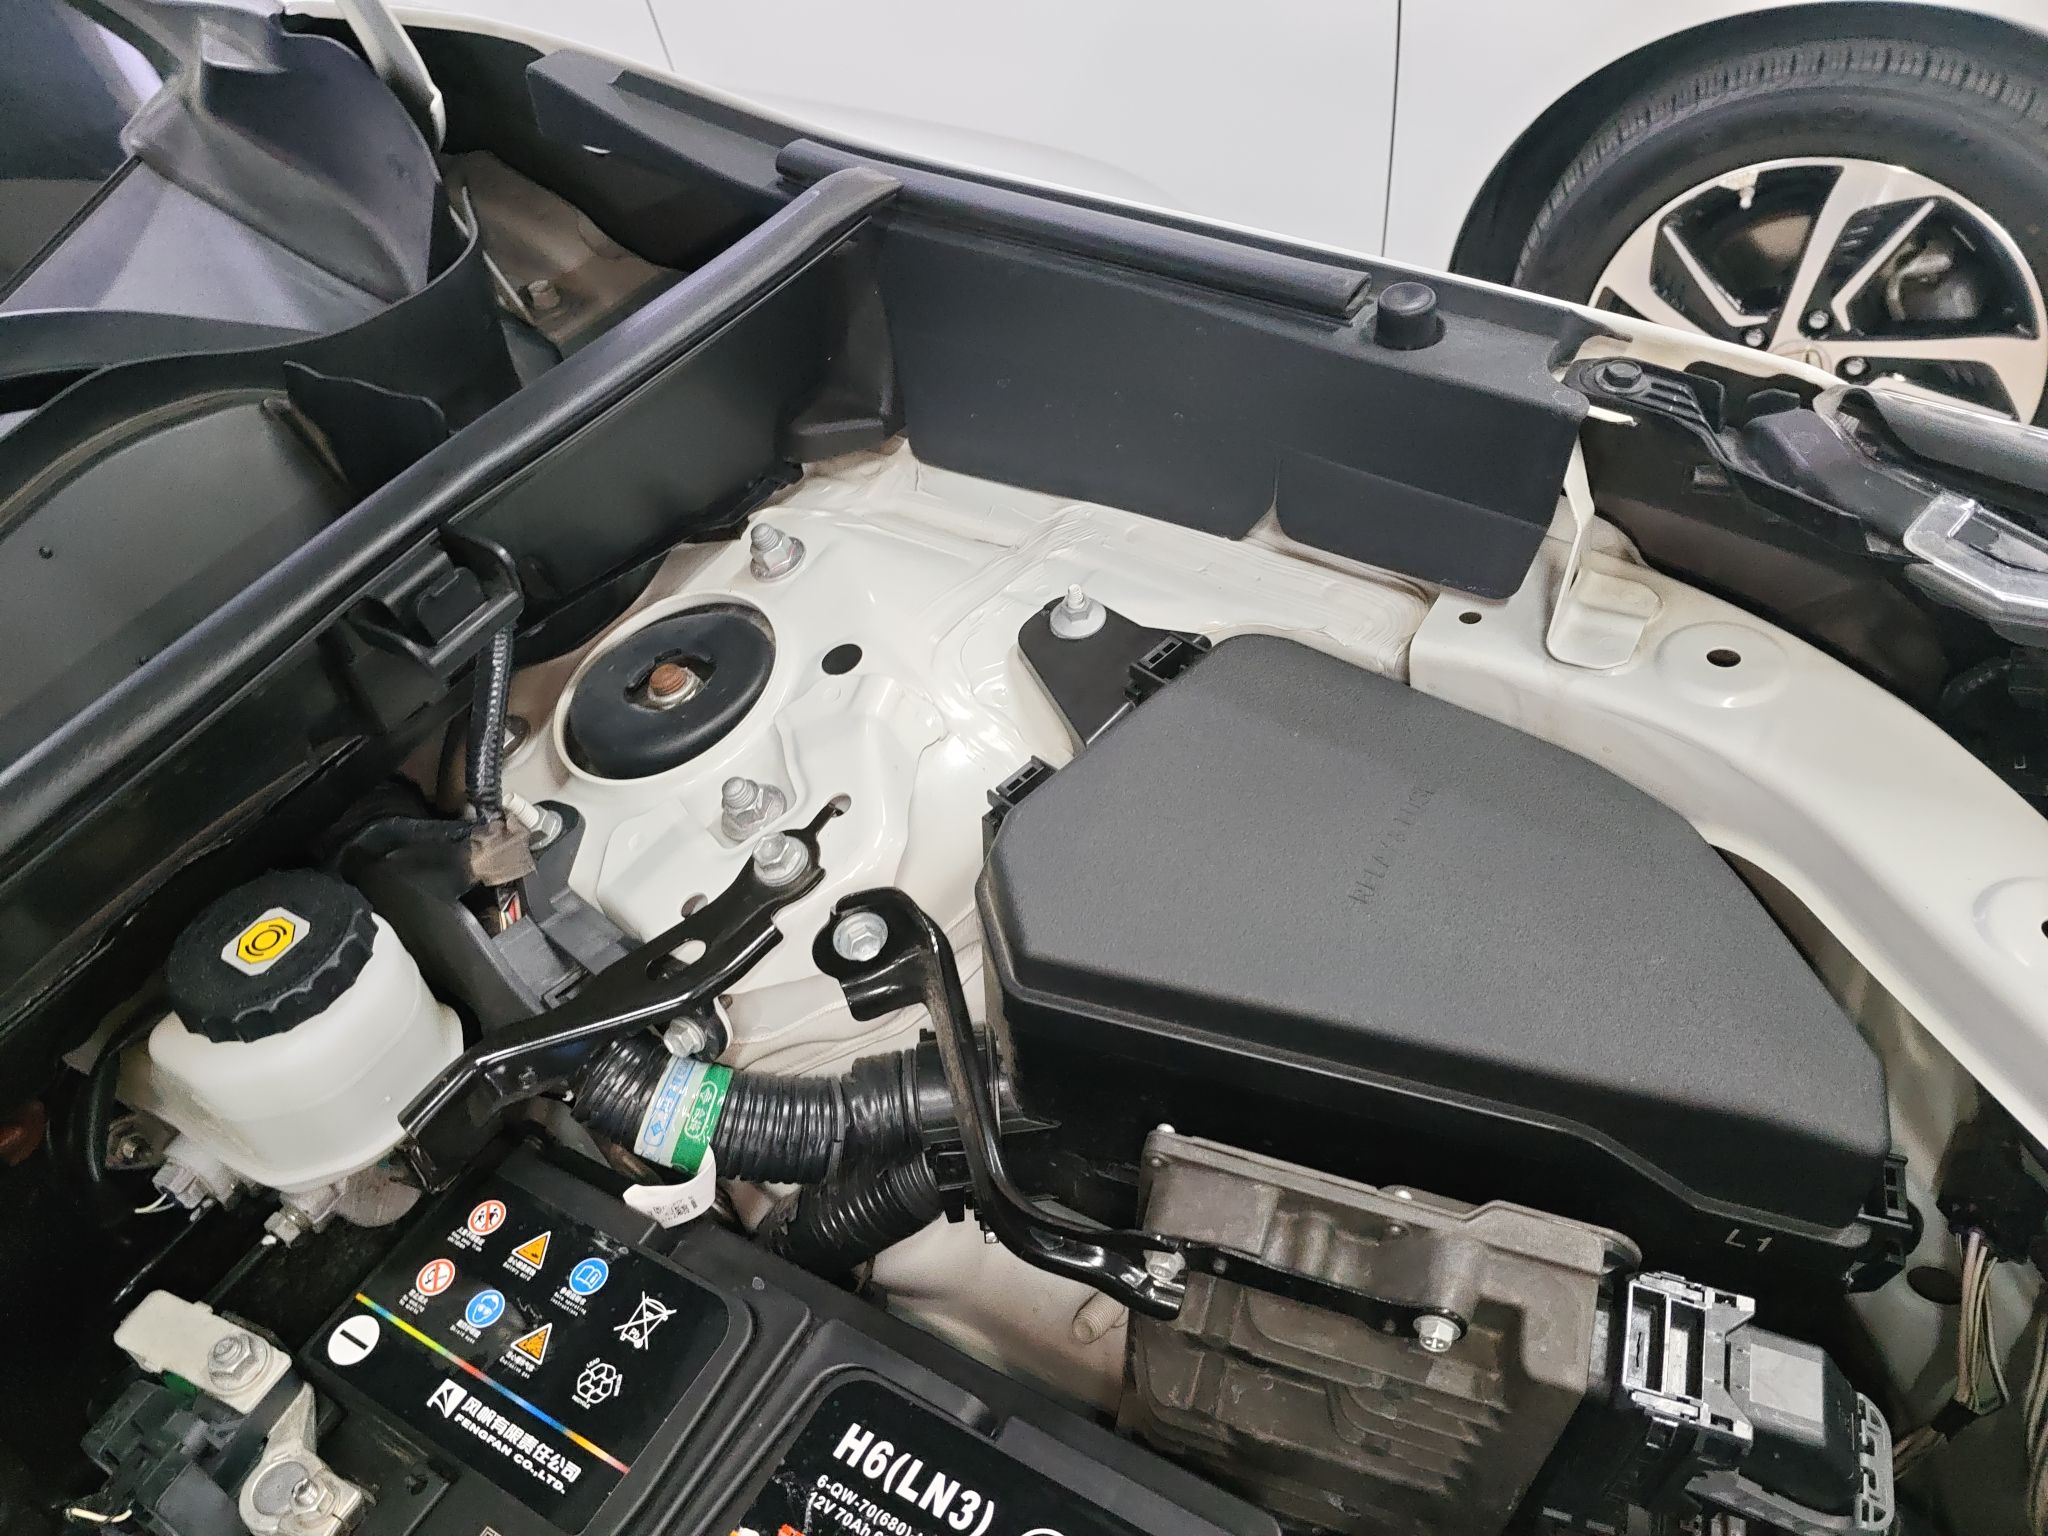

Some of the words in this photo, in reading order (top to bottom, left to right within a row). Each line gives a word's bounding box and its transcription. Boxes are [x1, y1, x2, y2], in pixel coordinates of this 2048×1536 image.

[1724, 1228, 1773, 1252] L1
[453, 1412, 513, 1457] FENGFAN
[460, 1396, 582, 1483] 风帆有限责任公司
[832, 1422, 995, 1536] H6(LN3)
[808, 1492, 836, 1514] 12V
